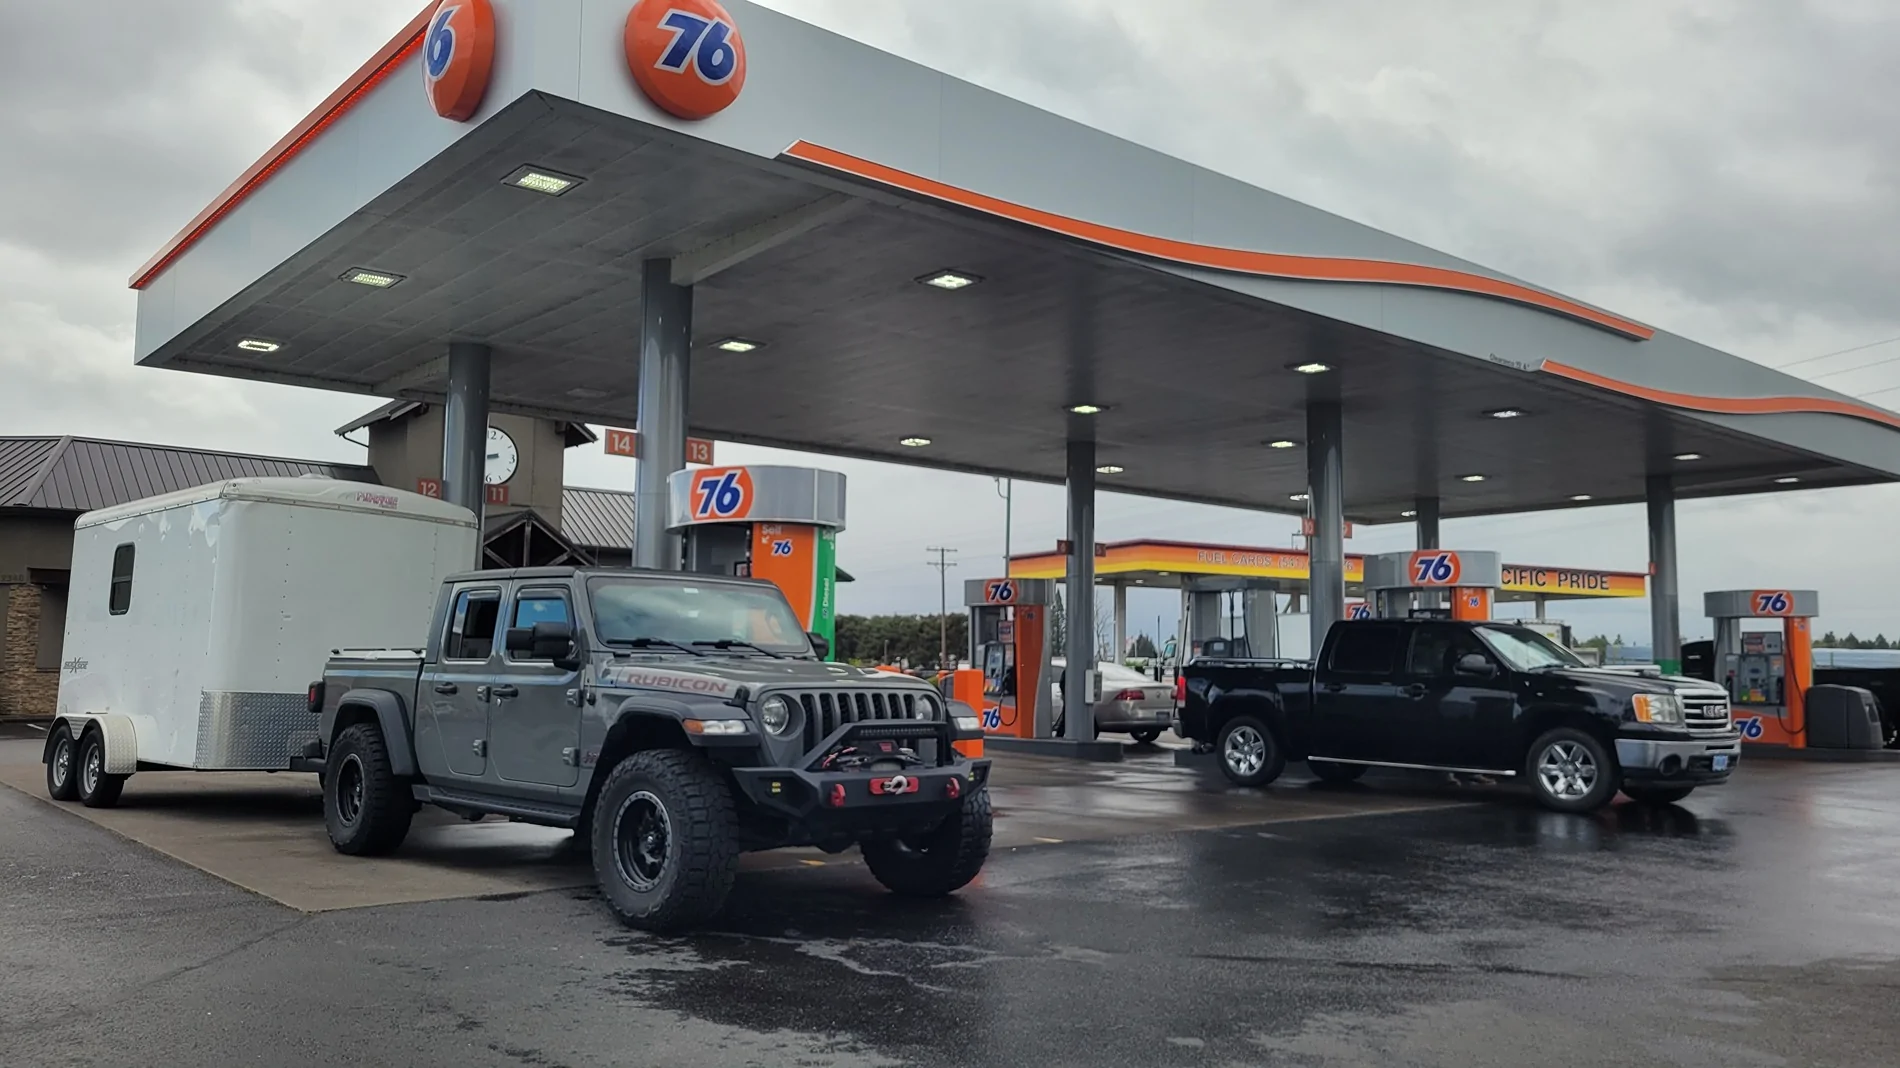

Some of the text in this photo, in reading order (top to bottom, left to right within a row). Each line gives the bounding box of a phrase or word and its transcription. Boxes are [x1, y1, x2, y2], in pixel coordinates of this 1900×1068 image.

[654, 8, 738, 85] 76
[612, 433, 631, 453] 14
[691, 442, 708, 461] 13
[509, 454, 516, 465] 3
[420, 481, 438, 497] 12
[491, 487, 504, 502] 11
[696, 469, 743, 519] 76
[1303, 519, 1314, 535] 10
[771, 539, 793, 557] 76
[1197, 552, 1226, 565] FUEL
[1231, 553, 1272, 567] CARDS
[1415, 553, 1454, 583] 76
[1557, 571, 1610, 590] PRIDE
[822, 578, 830, 607] Diesel
[988, 580, 1014, 603] 76
[1351, 602, 1372, 619] 76
[1468, 597, 1480, 608] 76
[1756, 592, 1788, 615] 76
[627, 672, 729, 693] RUBICON
[983, 708, 1001, 731] 76
[1732, 716, 1764, 740] 76
